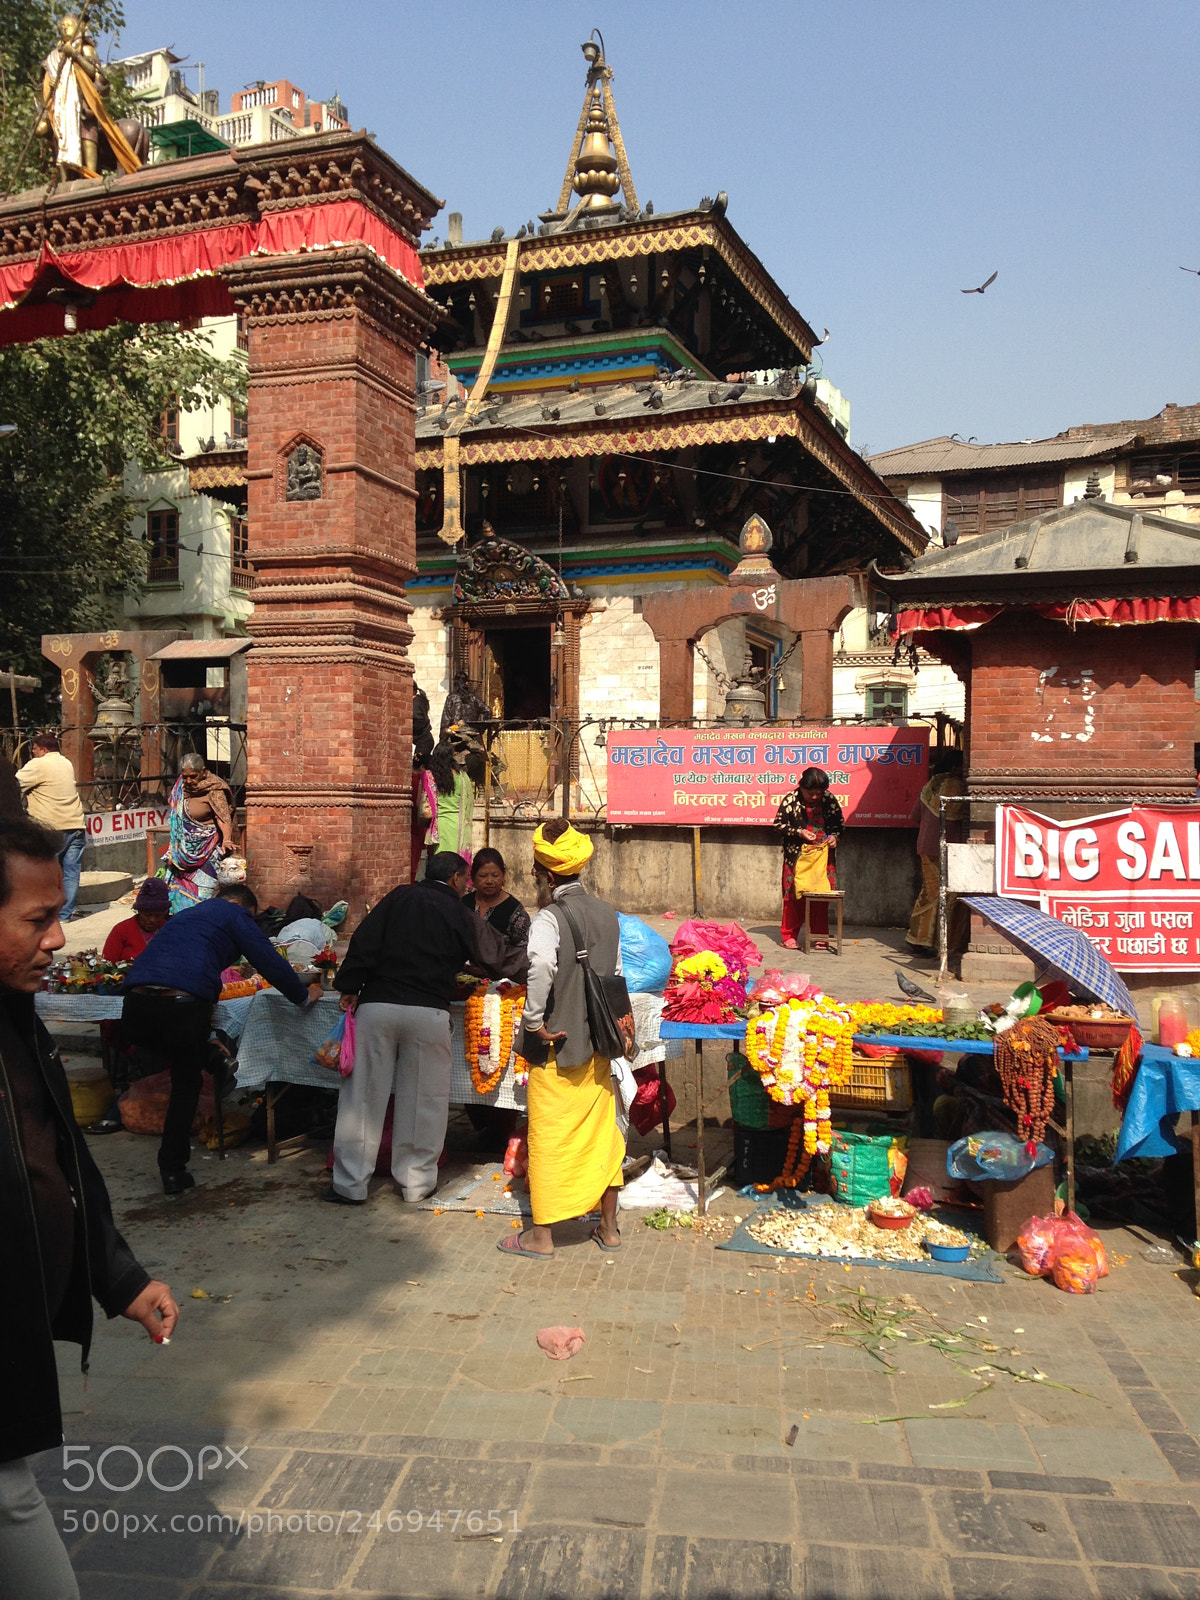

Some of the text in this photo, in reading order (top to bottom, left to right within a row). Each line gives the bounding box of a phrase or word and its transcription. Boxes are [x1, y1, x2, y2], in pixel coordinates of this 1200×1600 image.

[610, 739, 924, 767] महादेव मखन भजन मण्डल
[673, 771, 708, 785] प्रत्येक
[673, 789, 728, 807] निरन्तर
[112, 809, 168, 832] ENTRY
[1014, 821, 1100, 881] BIG
[1061, 906, 1110, 928] लेडिज
[1150, 911, 1194, 930] पसल
[1116, 932, 1167, 955] पछाडी
[1170, 937, 1190, 955] छ
